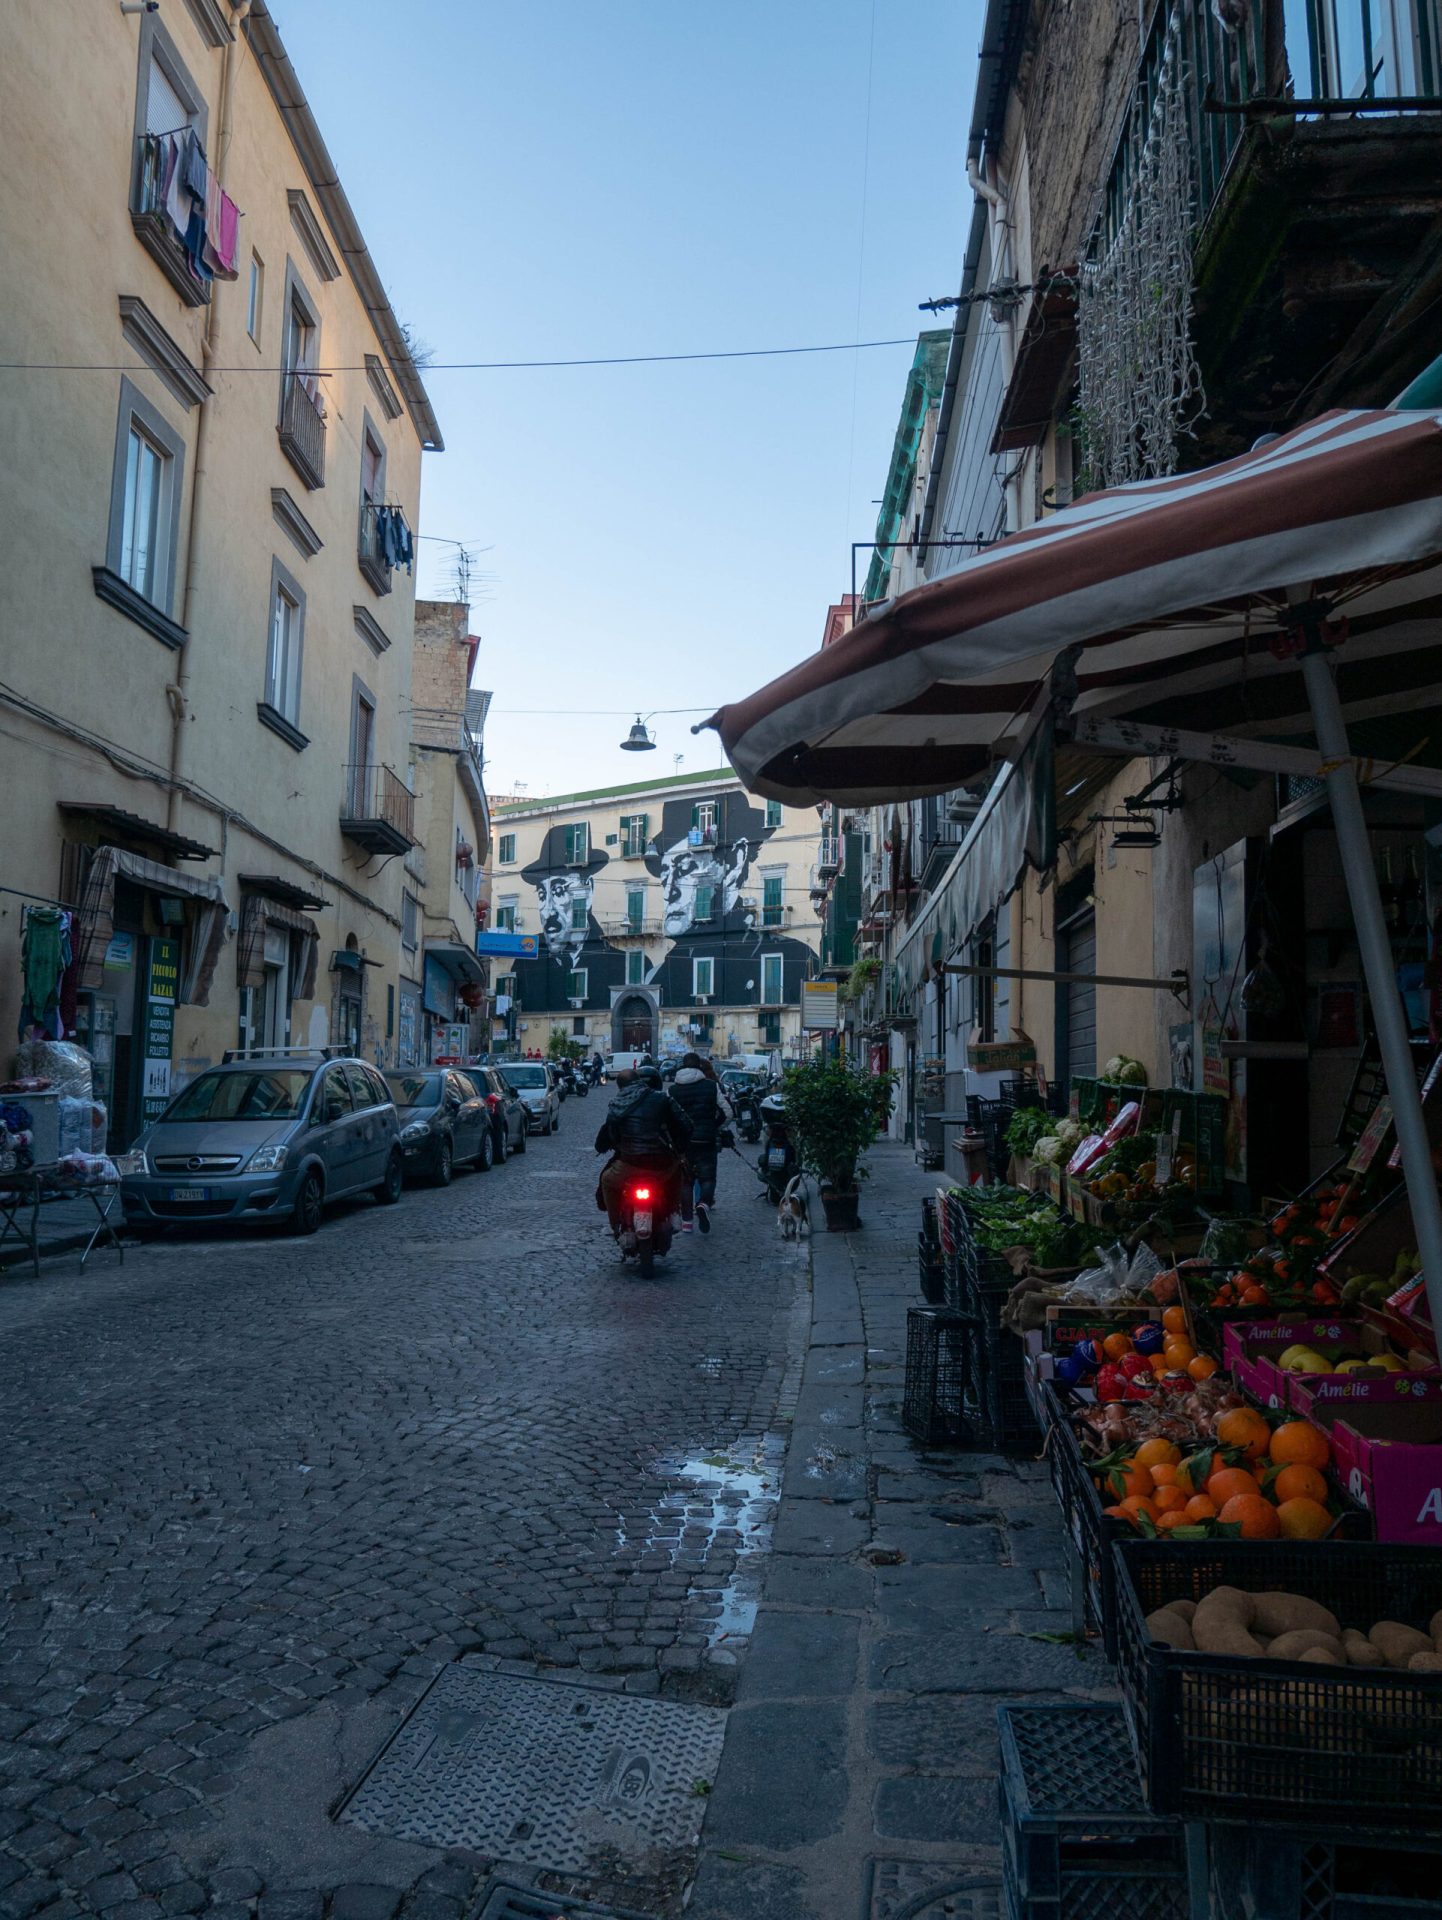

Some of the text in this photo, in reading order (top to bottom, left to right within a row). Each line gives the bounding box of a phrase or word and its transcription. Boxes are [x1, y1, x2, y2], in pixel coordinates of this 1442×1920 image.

[152, 963, 177, 979] PICCOLO
[152, 983, 174, 997] BAZAR
[1248, 1325, 1293, 1340] Amélie
[1317, 1381, 1370, 1398] Amélie
